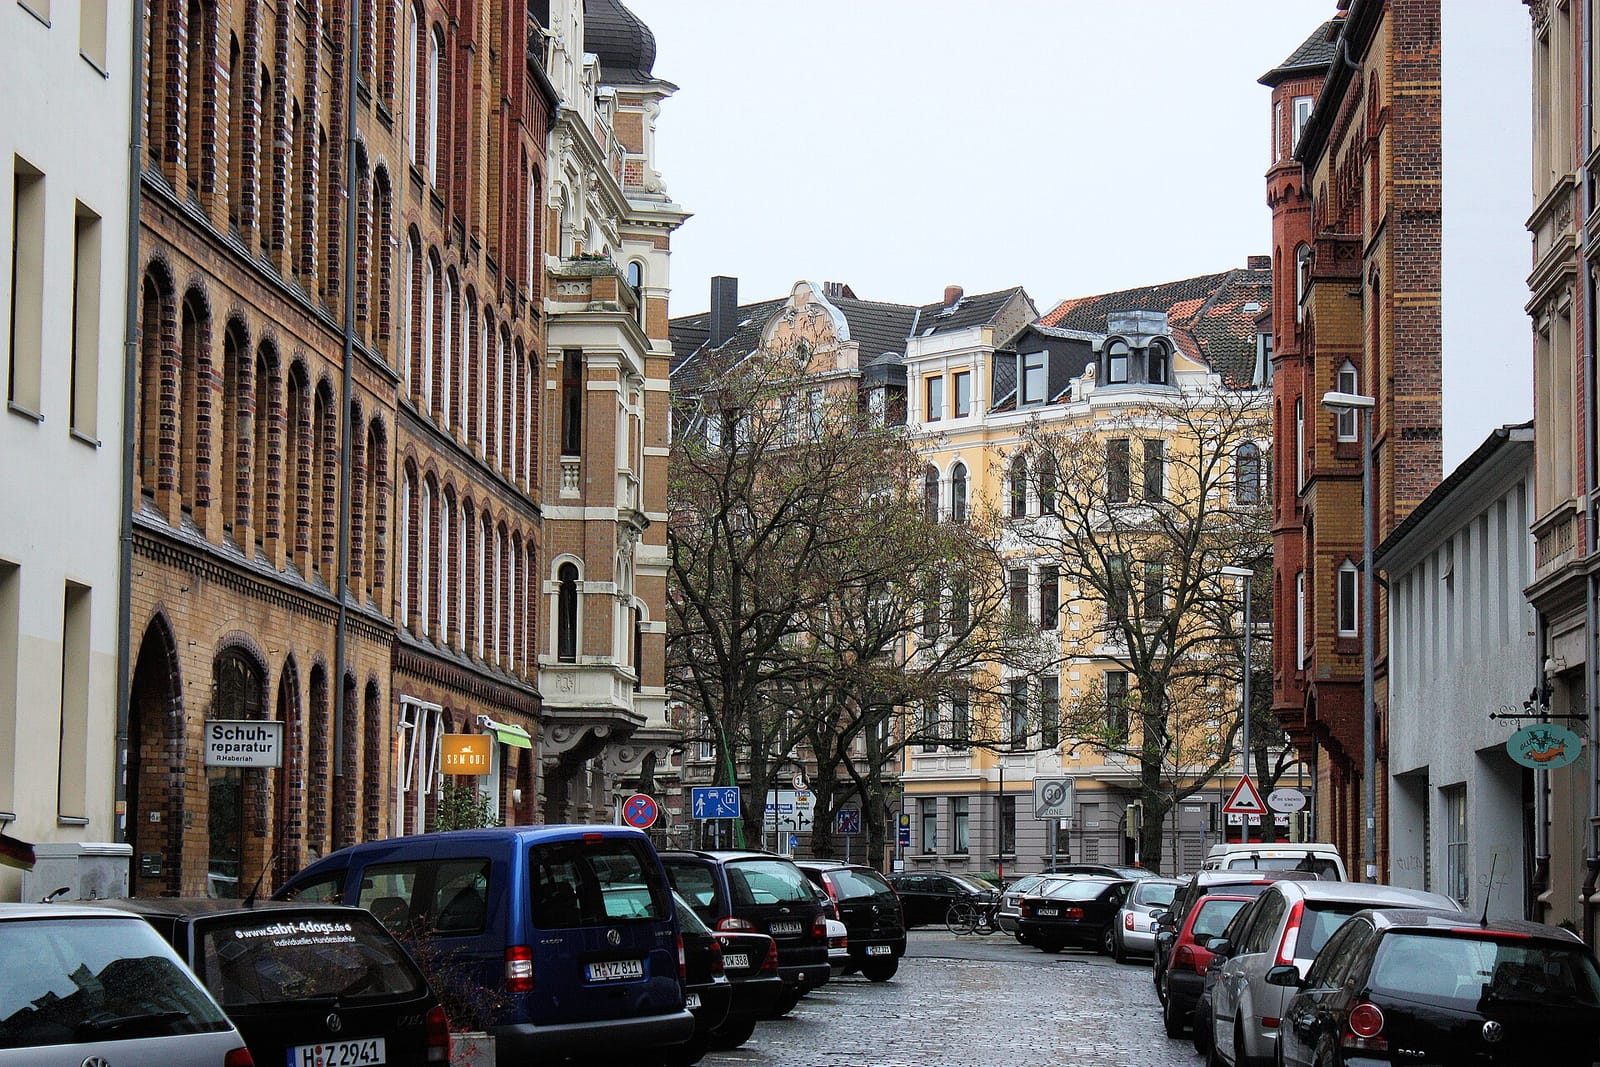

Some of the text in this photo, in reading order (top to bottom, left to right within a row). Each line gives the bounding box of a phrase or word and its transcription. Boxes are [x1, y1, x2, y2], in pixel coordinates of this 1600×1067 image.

[212, 725, 273, 740] Schuh-
[211, 742, 273, 754] reparatur
[1046, 788, 1062, 801] 30
[1045, 808, 1065, 816] ZONE
[242, 921, 345, 938] www.sabri-4dogs.de
[735, 954, 748, 966] 388
[594, 962, 639, 977] H YZ 811
[303, 1041, 380, 1067] H Z 2941
[1398, 1048, 1425, 1057] POLO
